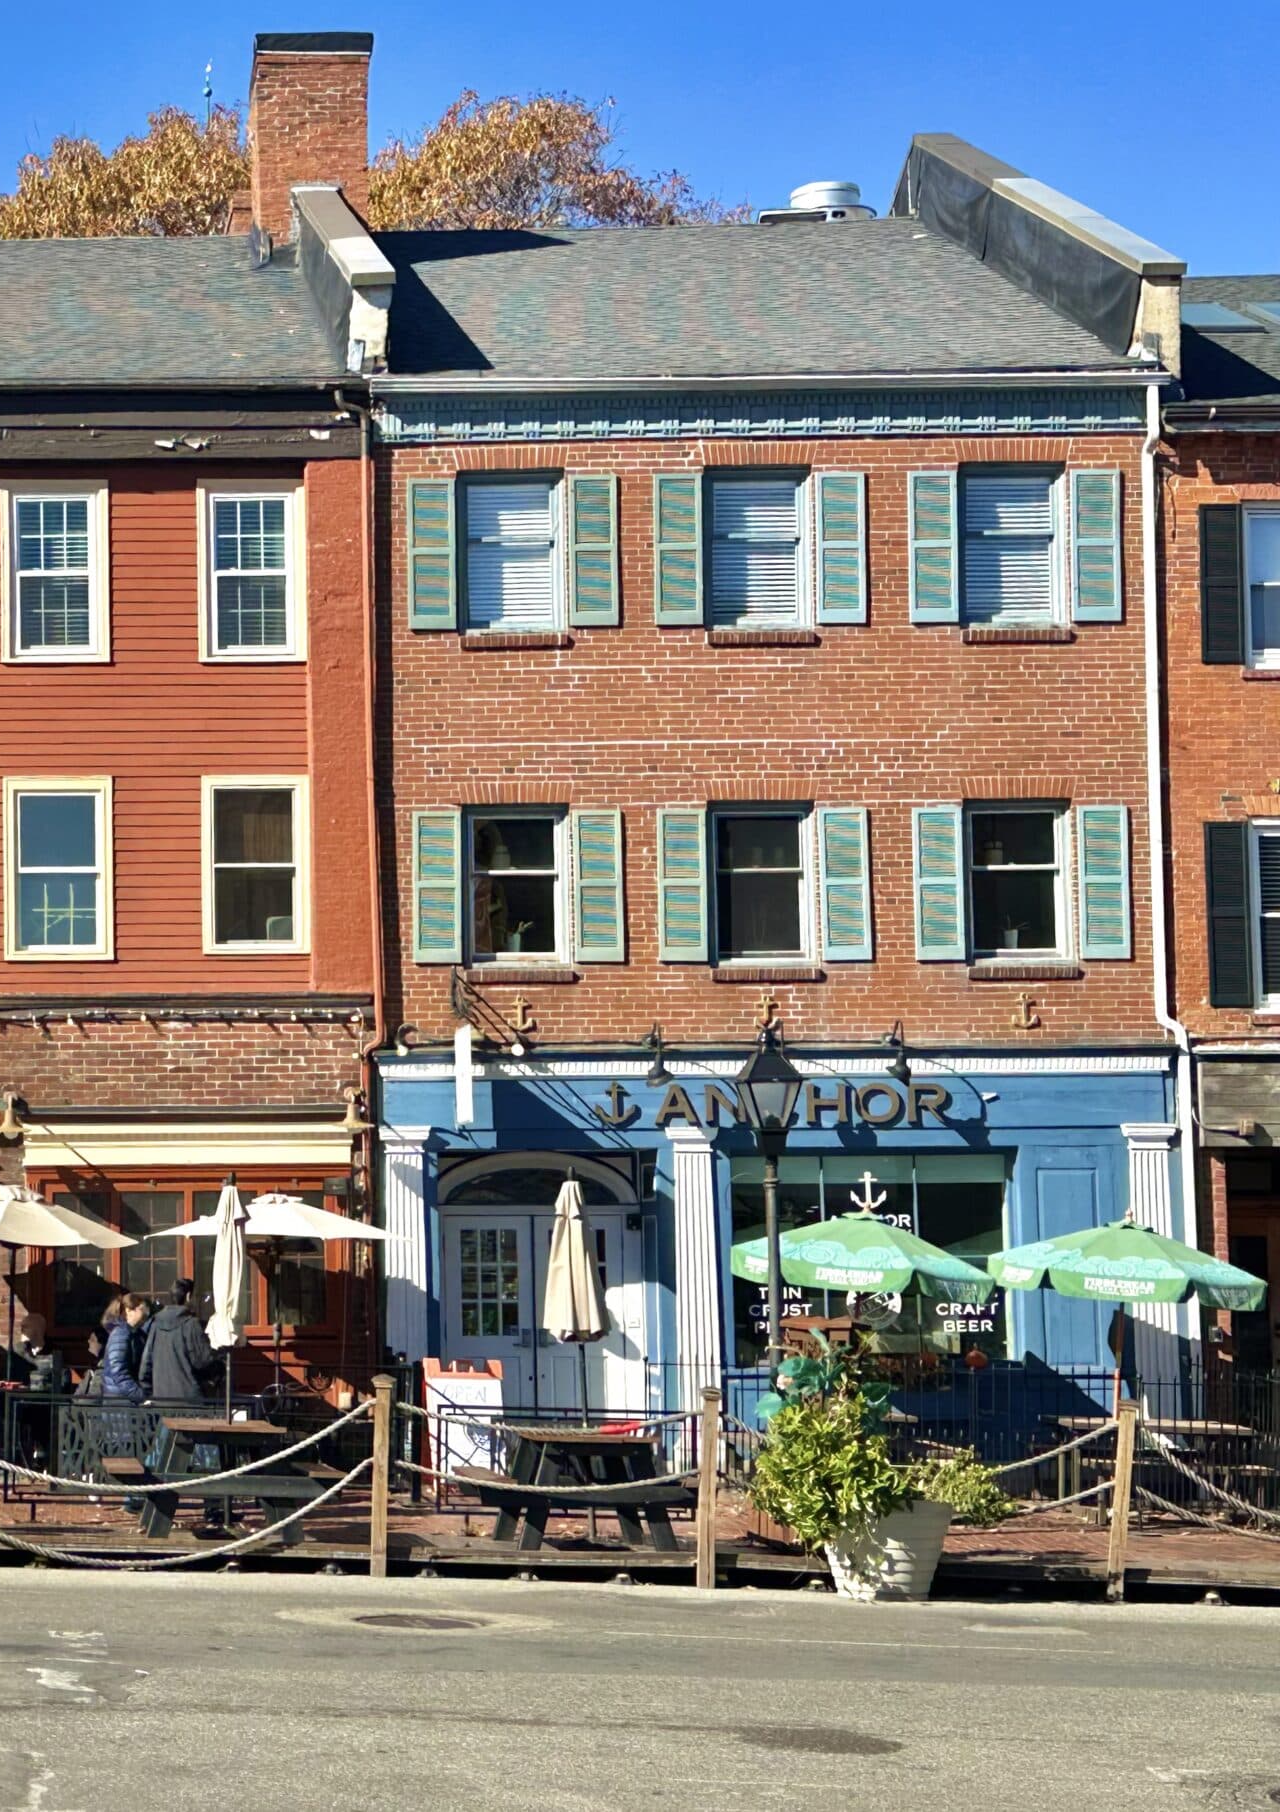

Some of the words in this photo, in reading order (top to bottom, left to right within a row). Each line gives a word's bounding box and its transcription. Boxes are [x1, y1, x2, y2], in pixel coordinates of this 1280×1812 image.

[654, 1082, 954, 1126] ANHOR
[759, 1286, 802, 1299] TIN
[935, 1302, 999, 1316] CRAFT
[943, 1320, 994, 1332] BEER
